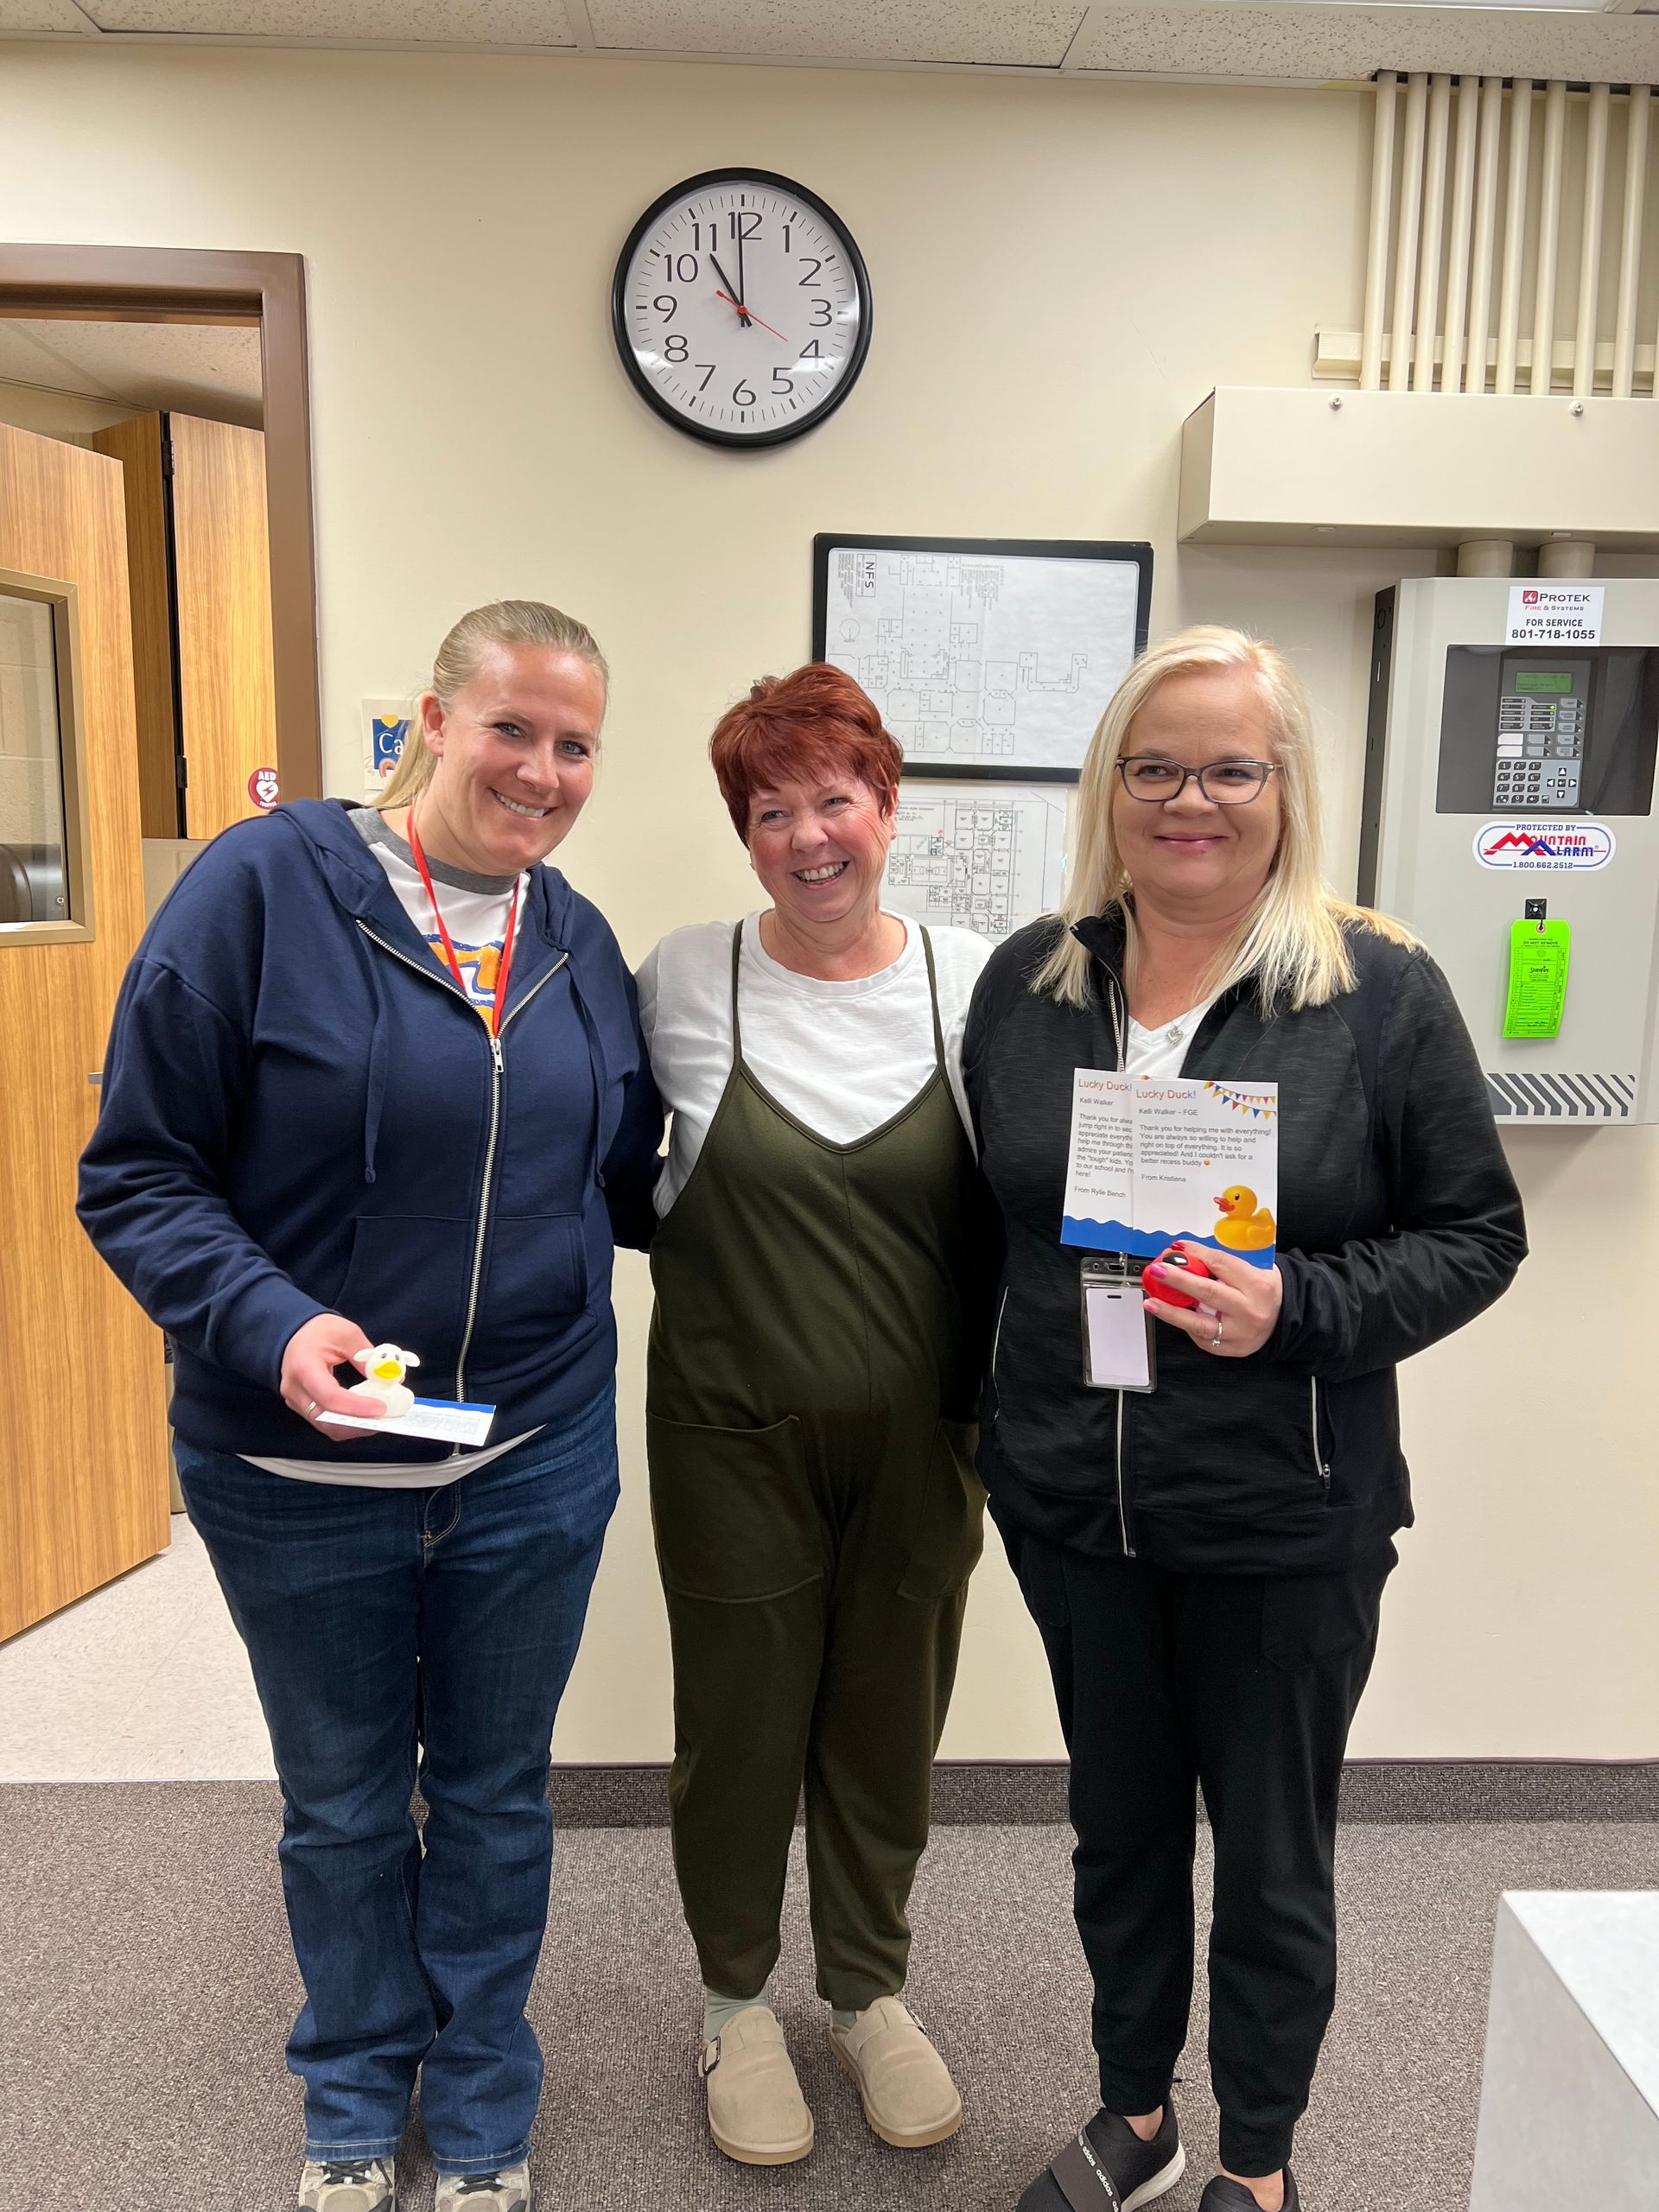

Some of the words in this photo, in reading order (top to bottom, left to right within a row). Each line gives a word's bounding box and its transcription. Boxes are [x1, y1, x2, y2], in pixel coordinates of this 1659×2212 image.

[691, 223, 717, 251] 11
[728, 211, 762, 240] 12
[782, 225, 790, 253] 1
[664, 254, 698, 283] 10
[798, 258, 822, 287] 2
[653, 295, 677, 323] 9
[809, 299, 833, 327] 3
[664, 335, 690, 363] 8
[799, 339, 825, 369] 4
[695, 365, 716, 391] 7
[733, 378, 757, 406] 6
[772, 367, 794, 395] 5
[865, 562, 874, 588] NFS
[1540, 594, 1590, 602] PROTEK
[1512, 629, 1595, 639] 801-718-1055
[257, 771, 276, 780] AED
[1078, 1078, 1103, 1090] Lucky
[1106, 1081, 1132, 1091] Duck!
[1136, 1090, 1164, 1100] Lucky
[1167, 1090, 1196, 1099] Duck!
[1082, 2146, 1096, 2167] adidas
[1096, 2170, 1113, 2196] adidas
